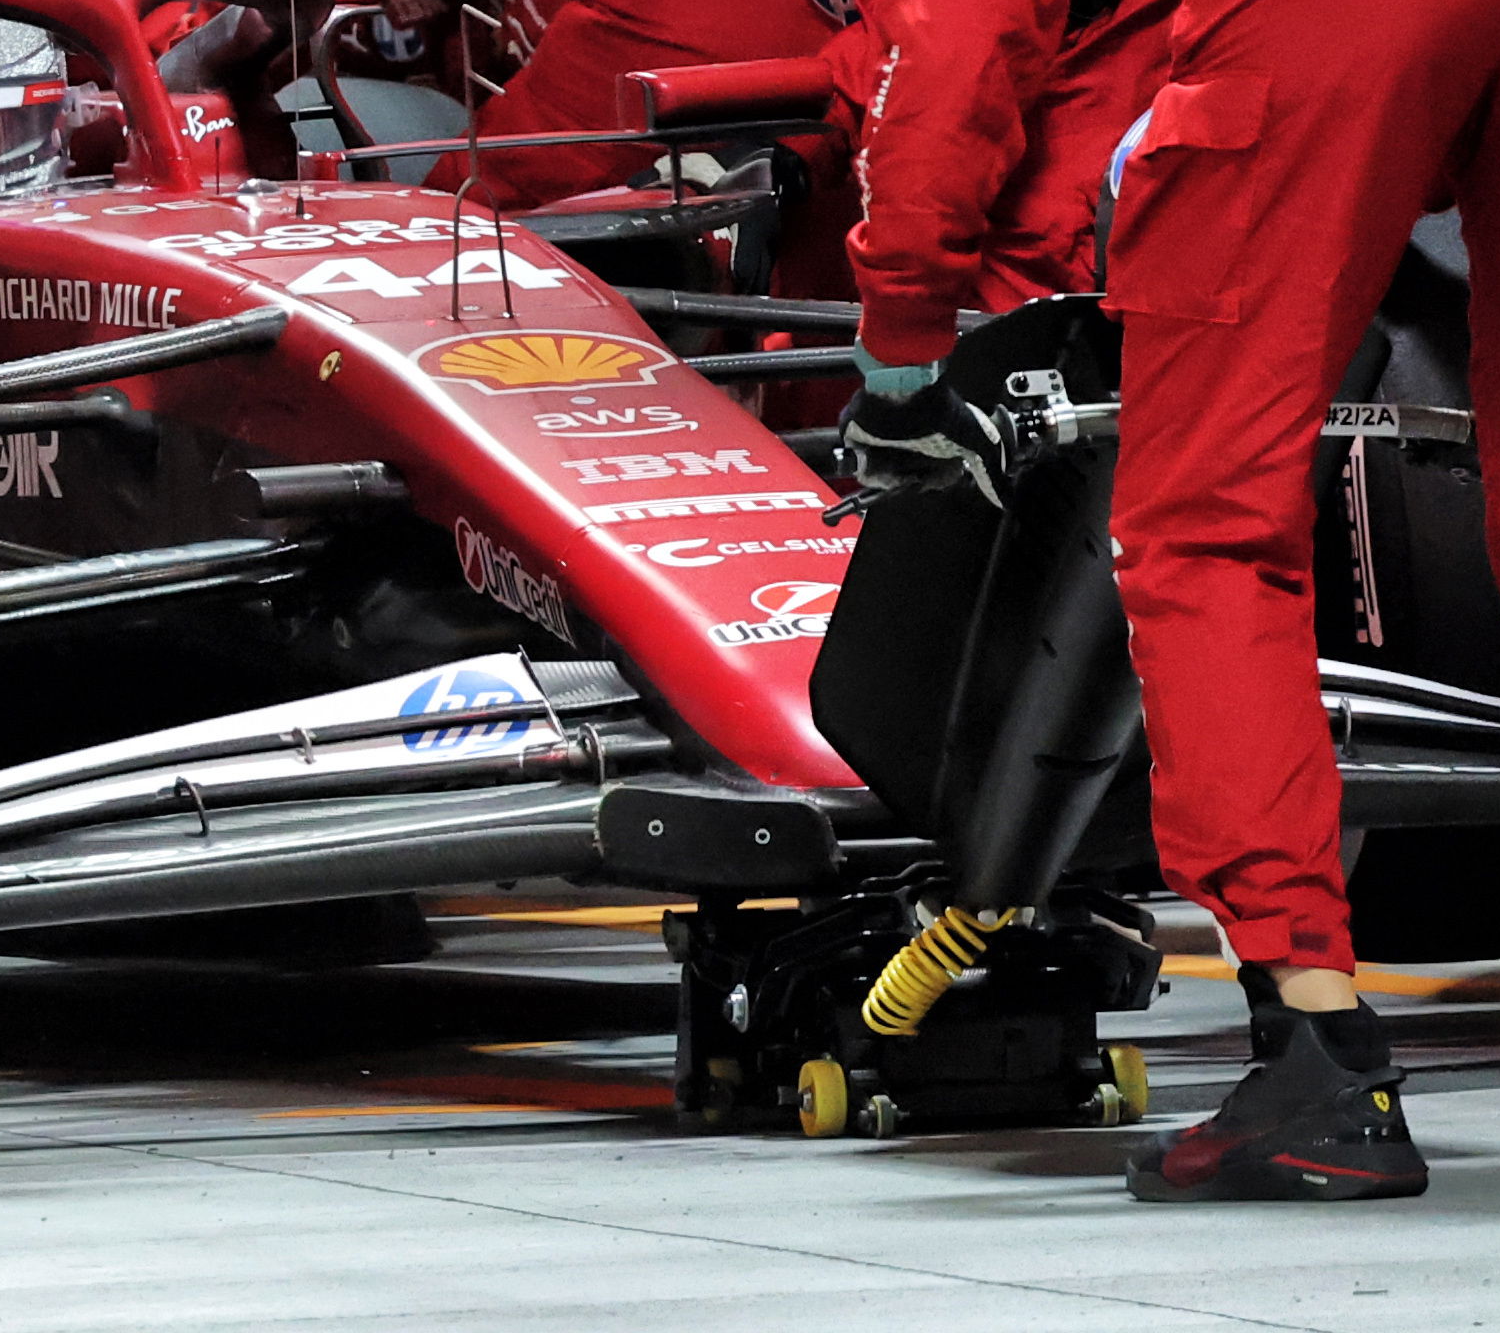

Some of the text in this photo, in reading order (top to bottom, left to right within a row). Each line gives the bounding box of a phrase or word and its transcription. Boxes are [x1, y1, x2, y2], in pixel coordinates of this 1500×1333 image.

[147, 214, 509, 250] GLOBAL
[200, 225, 517, 257] POKER
[285, 248, 573, 298] 44
[99, 282, 183, 330] MILLE
[532, 405, 688, 430] aws
[558, 448, 769, 485] IBM
[582, 490, 827, 524] PIRELLI
